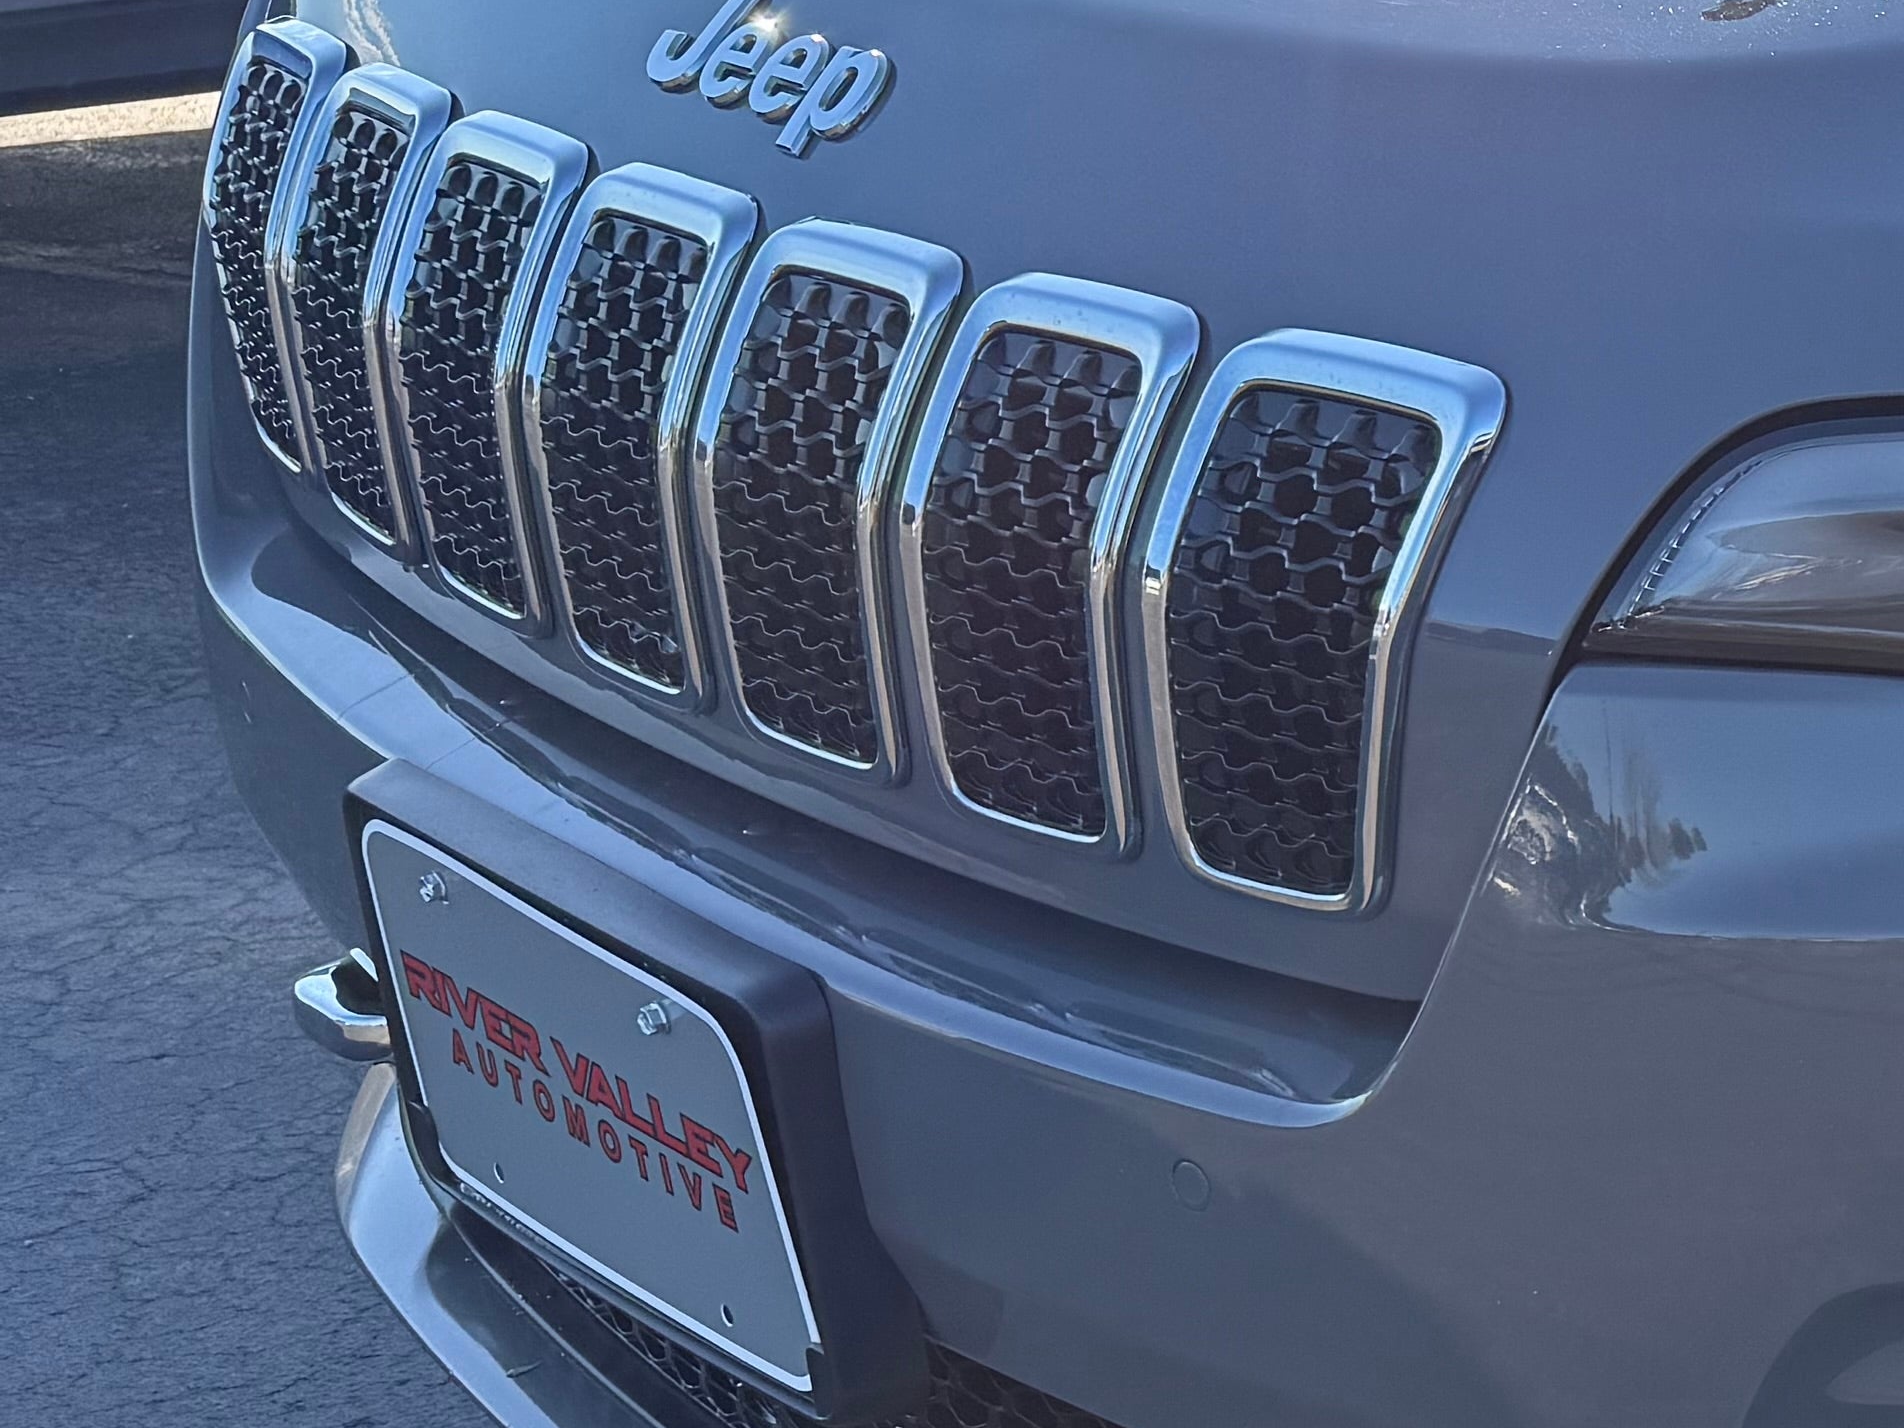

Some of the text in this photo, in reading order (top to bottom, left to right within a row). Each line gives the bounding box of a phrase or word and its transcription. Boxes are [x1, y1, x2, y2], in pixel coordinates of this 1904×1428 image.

[399, 949, 753, 1194] RIVER VALLEY
[451, 1028, 739, 1234] AUTOMOTIVE
